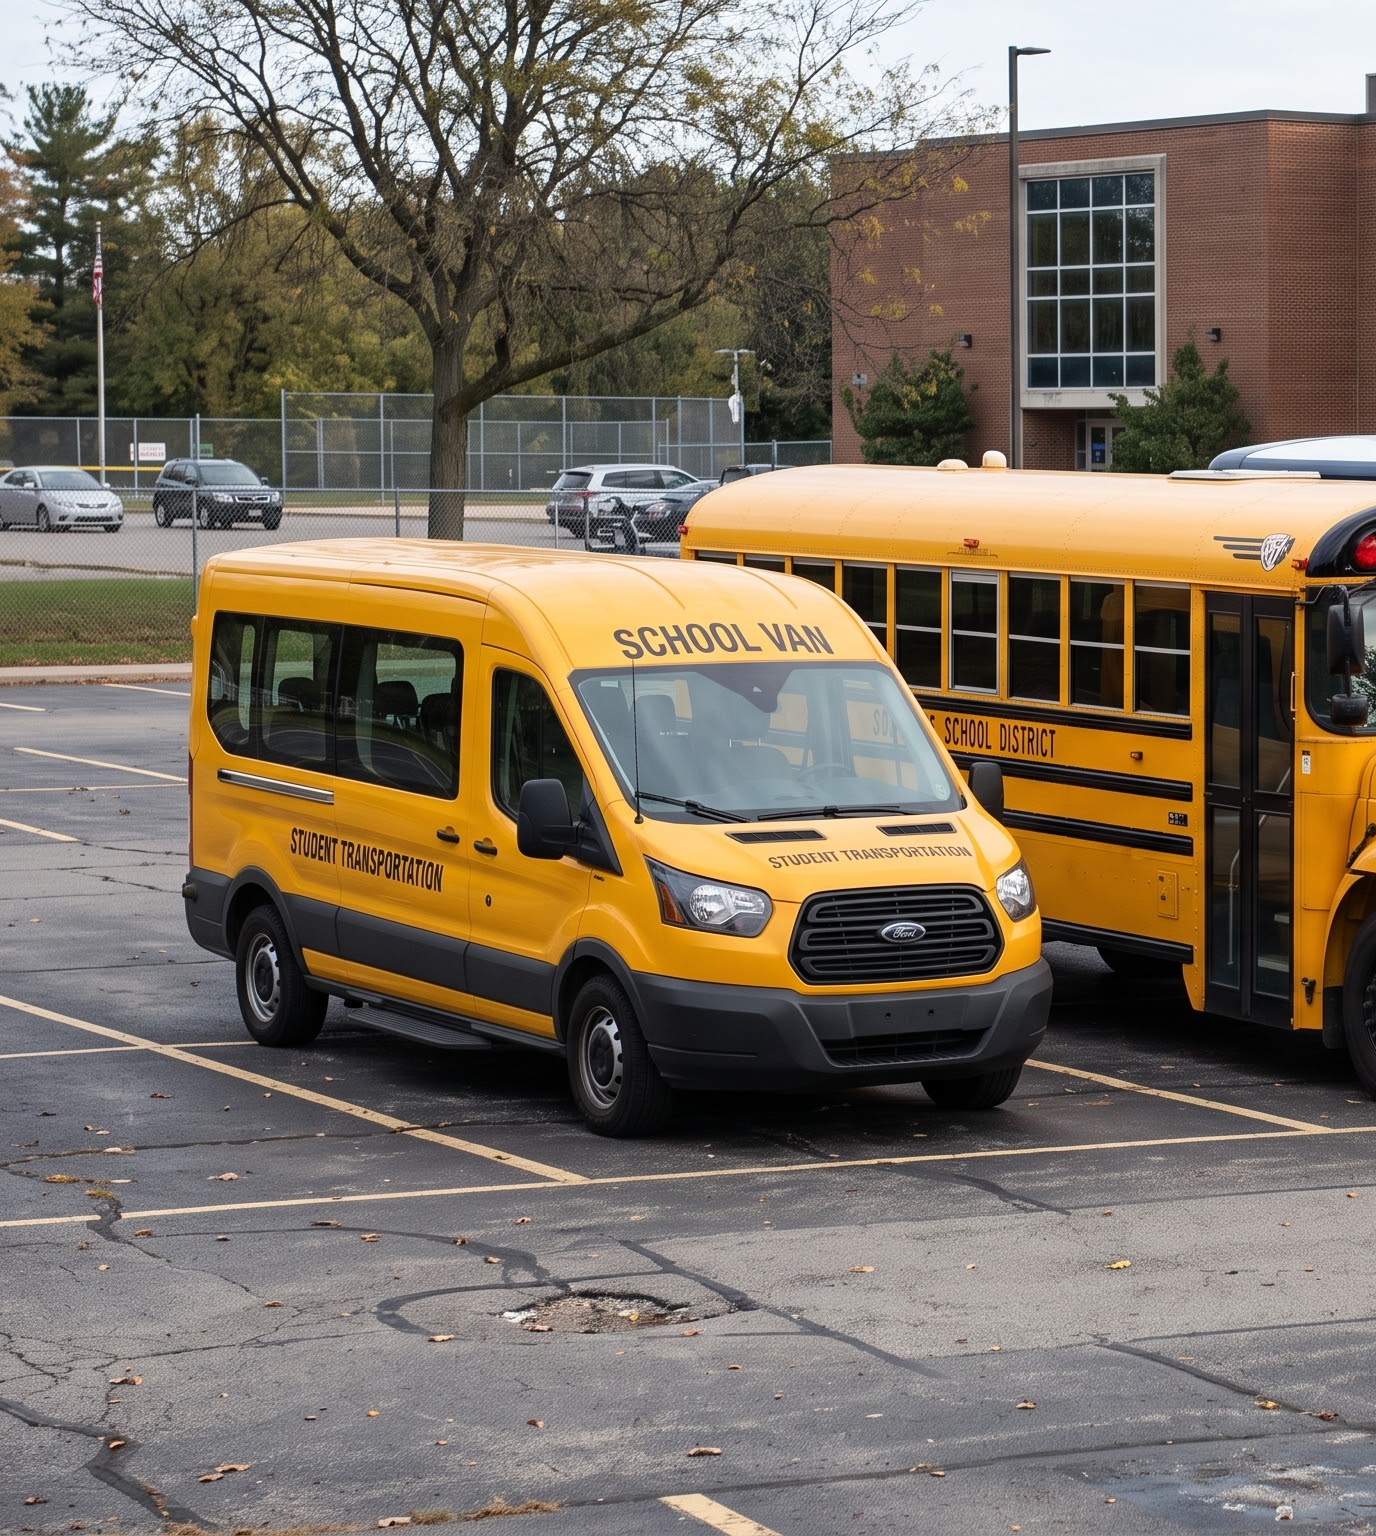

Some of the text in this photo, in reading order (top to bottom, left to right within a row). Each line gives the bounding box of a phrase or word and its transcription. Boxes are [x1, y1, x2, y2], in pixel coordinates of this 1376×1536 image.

[613, 622, 835, 660] SCHOOL VAN
[944, 716, 992, 750] SCHOOL
[1000, 722, 1056, 758] DISTRICT
[290, 827, 444, 892] STUDENT TRANSPORTATION
[768, 846, 973, 869] STUDENT TRANSPORTATION
